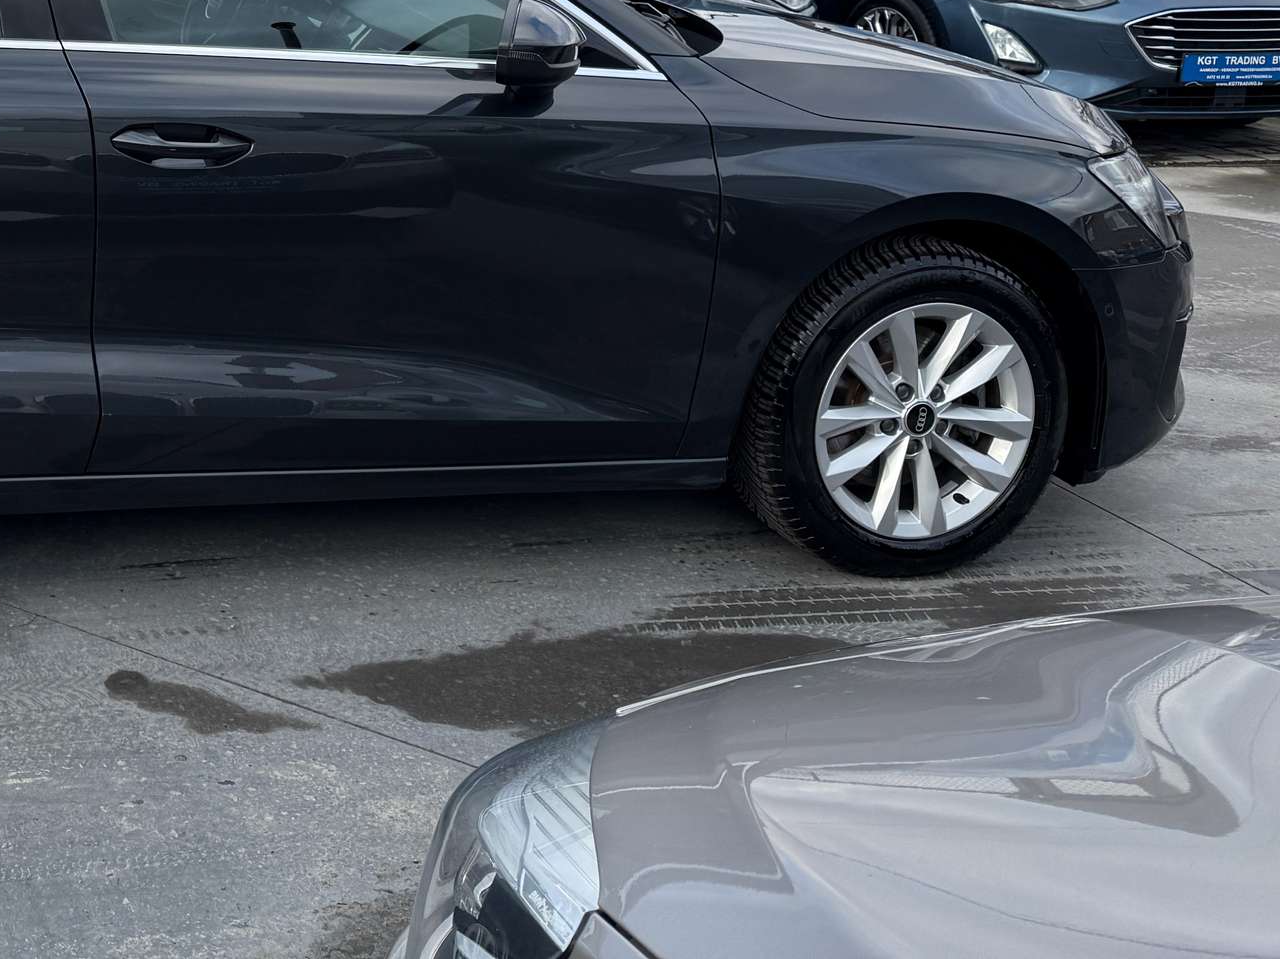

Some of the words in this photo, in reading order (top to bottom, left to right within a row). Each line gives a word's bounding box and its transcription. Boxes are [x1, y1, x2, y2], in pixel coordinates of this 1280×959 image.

[1197, 56, 1218, 65] KGT
[1225, 56, 1266, 65] TRADING
[1272, 55, 1280, 65] B
